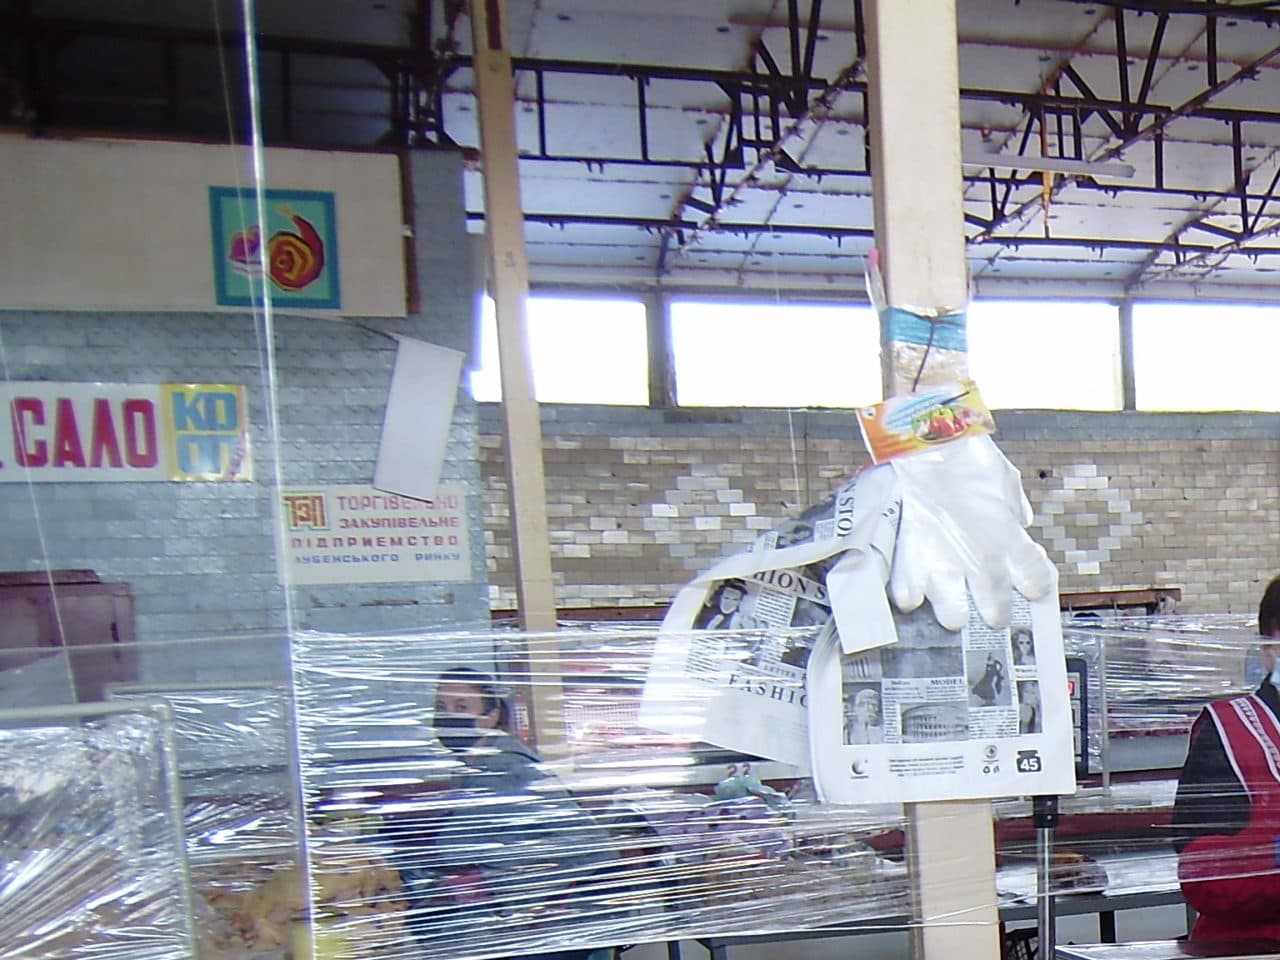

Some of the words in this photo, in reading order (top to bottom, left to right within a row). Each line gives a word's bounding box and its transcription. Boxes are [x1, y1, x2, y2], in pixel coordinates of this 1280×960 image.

[11, 396, 158, 468] САЛО
[339, 516, 459, 529] ЗАКУПІВЕЛЬНЕ
[1020, 758, 1038, 771] 45
